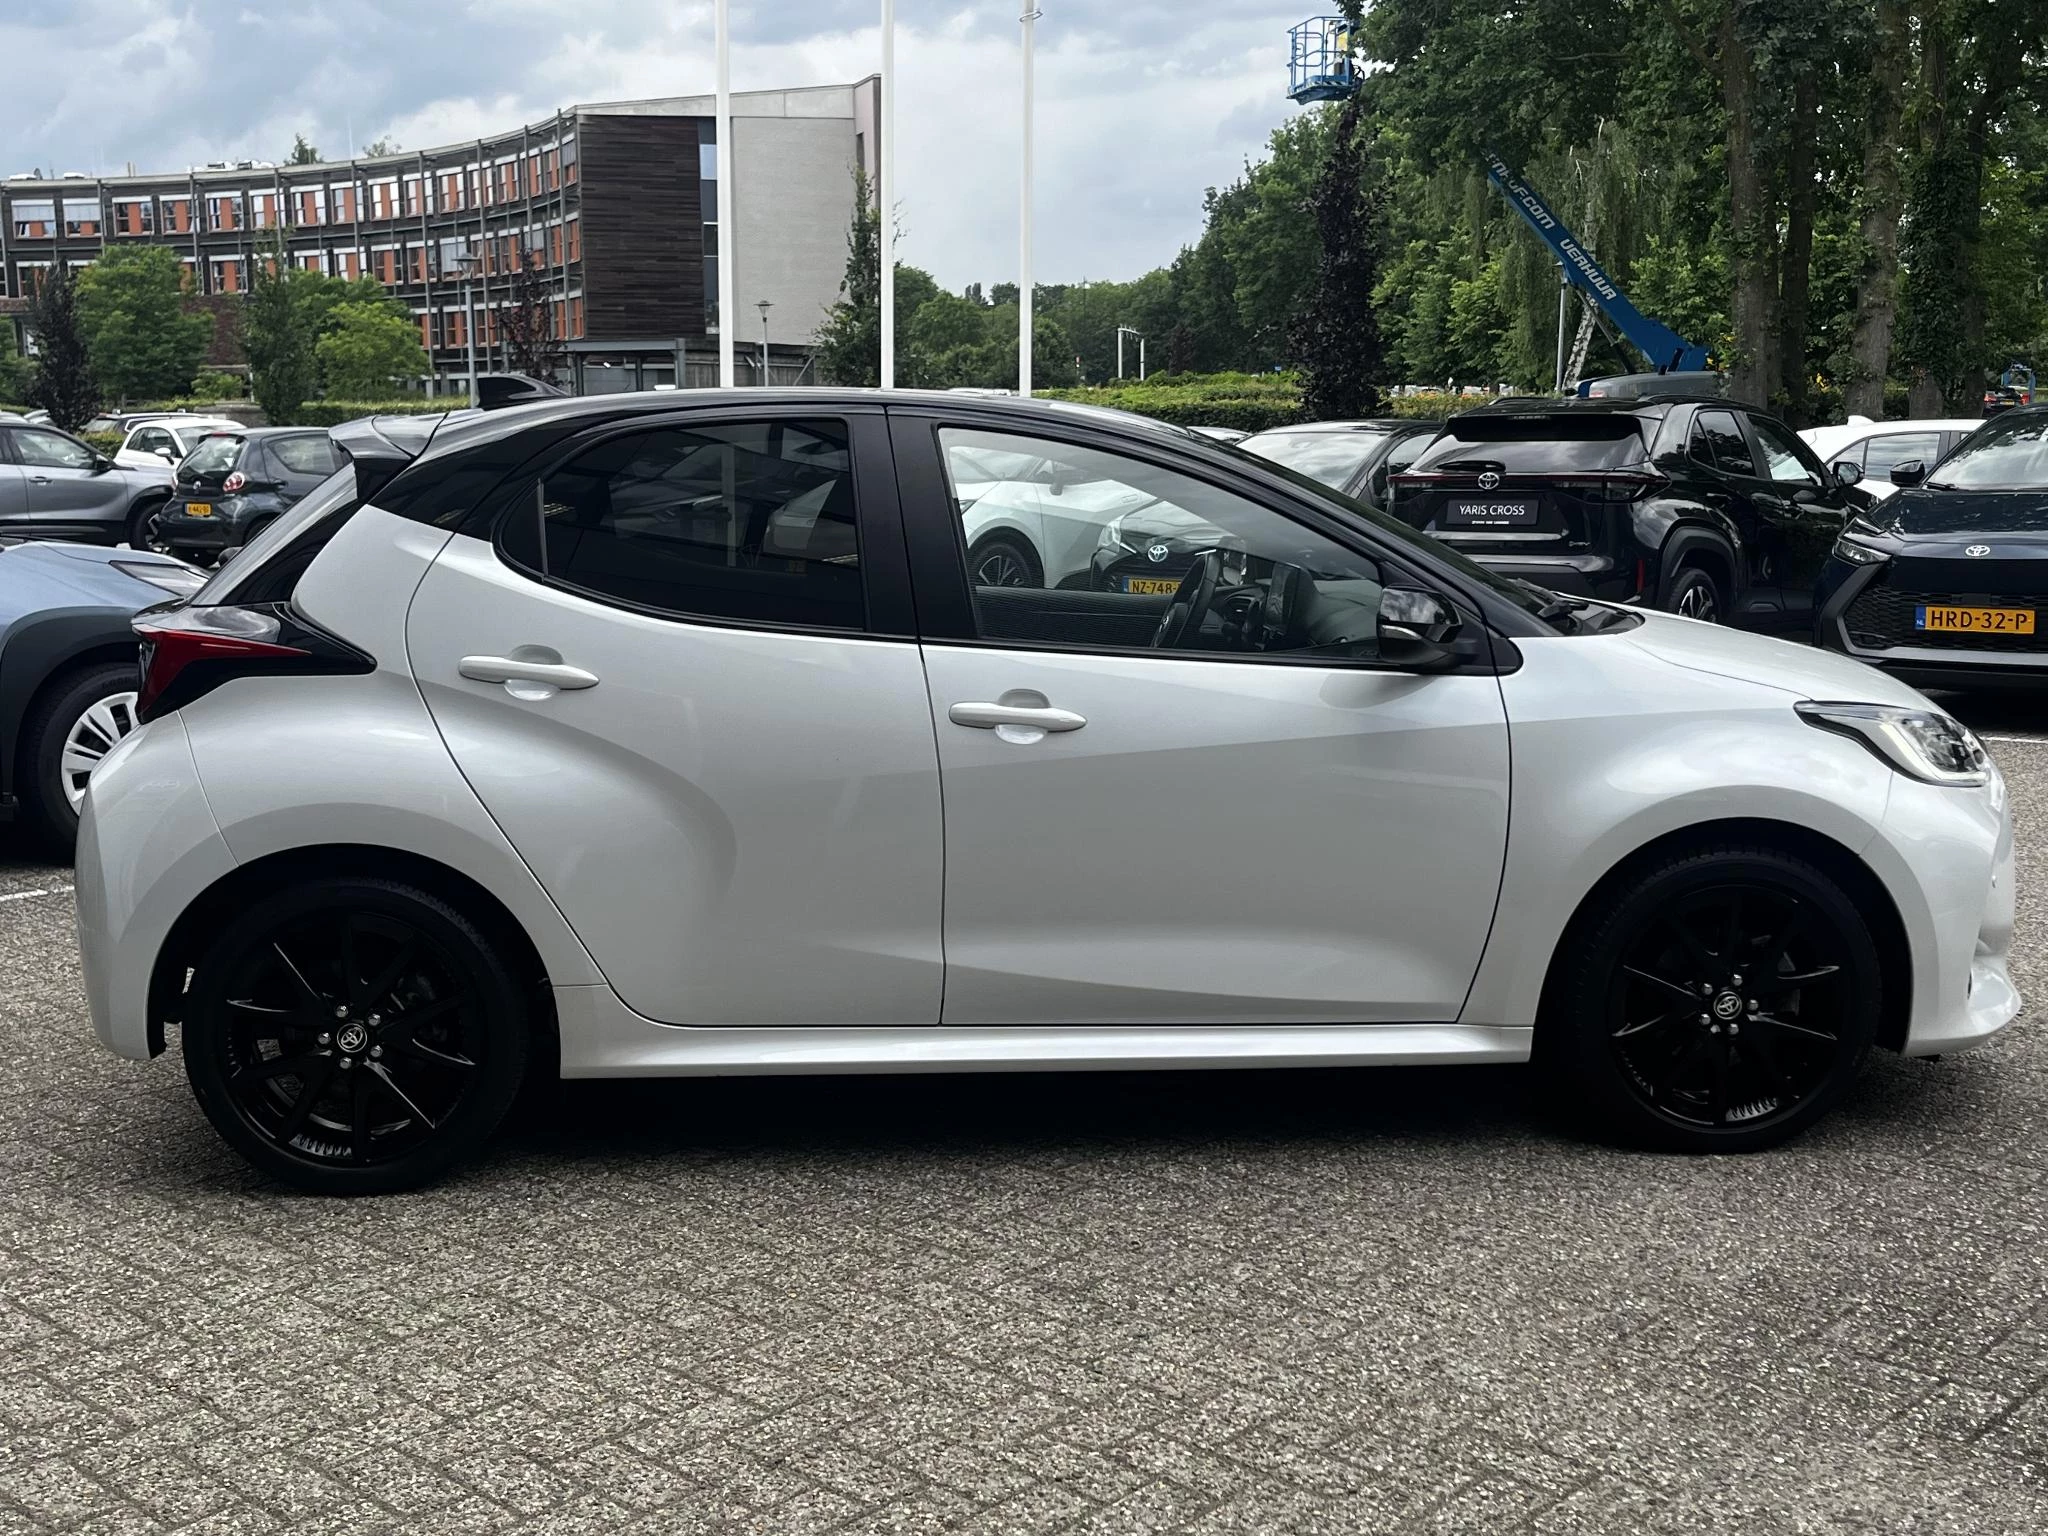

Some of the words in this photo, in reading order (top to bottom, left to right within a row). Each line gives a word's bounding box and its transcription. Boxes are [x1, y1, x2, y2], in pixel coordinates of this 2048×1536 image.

[1560, 238, 1617, 300] VERHUUR
[1459, 505, 1487, 515] YARIS
[1489, 505, 1525, 515] CROSS
[1132, 581, 1181, 594] NZ-748-
[1931, 610, 2028, 630] HRD-32-P
